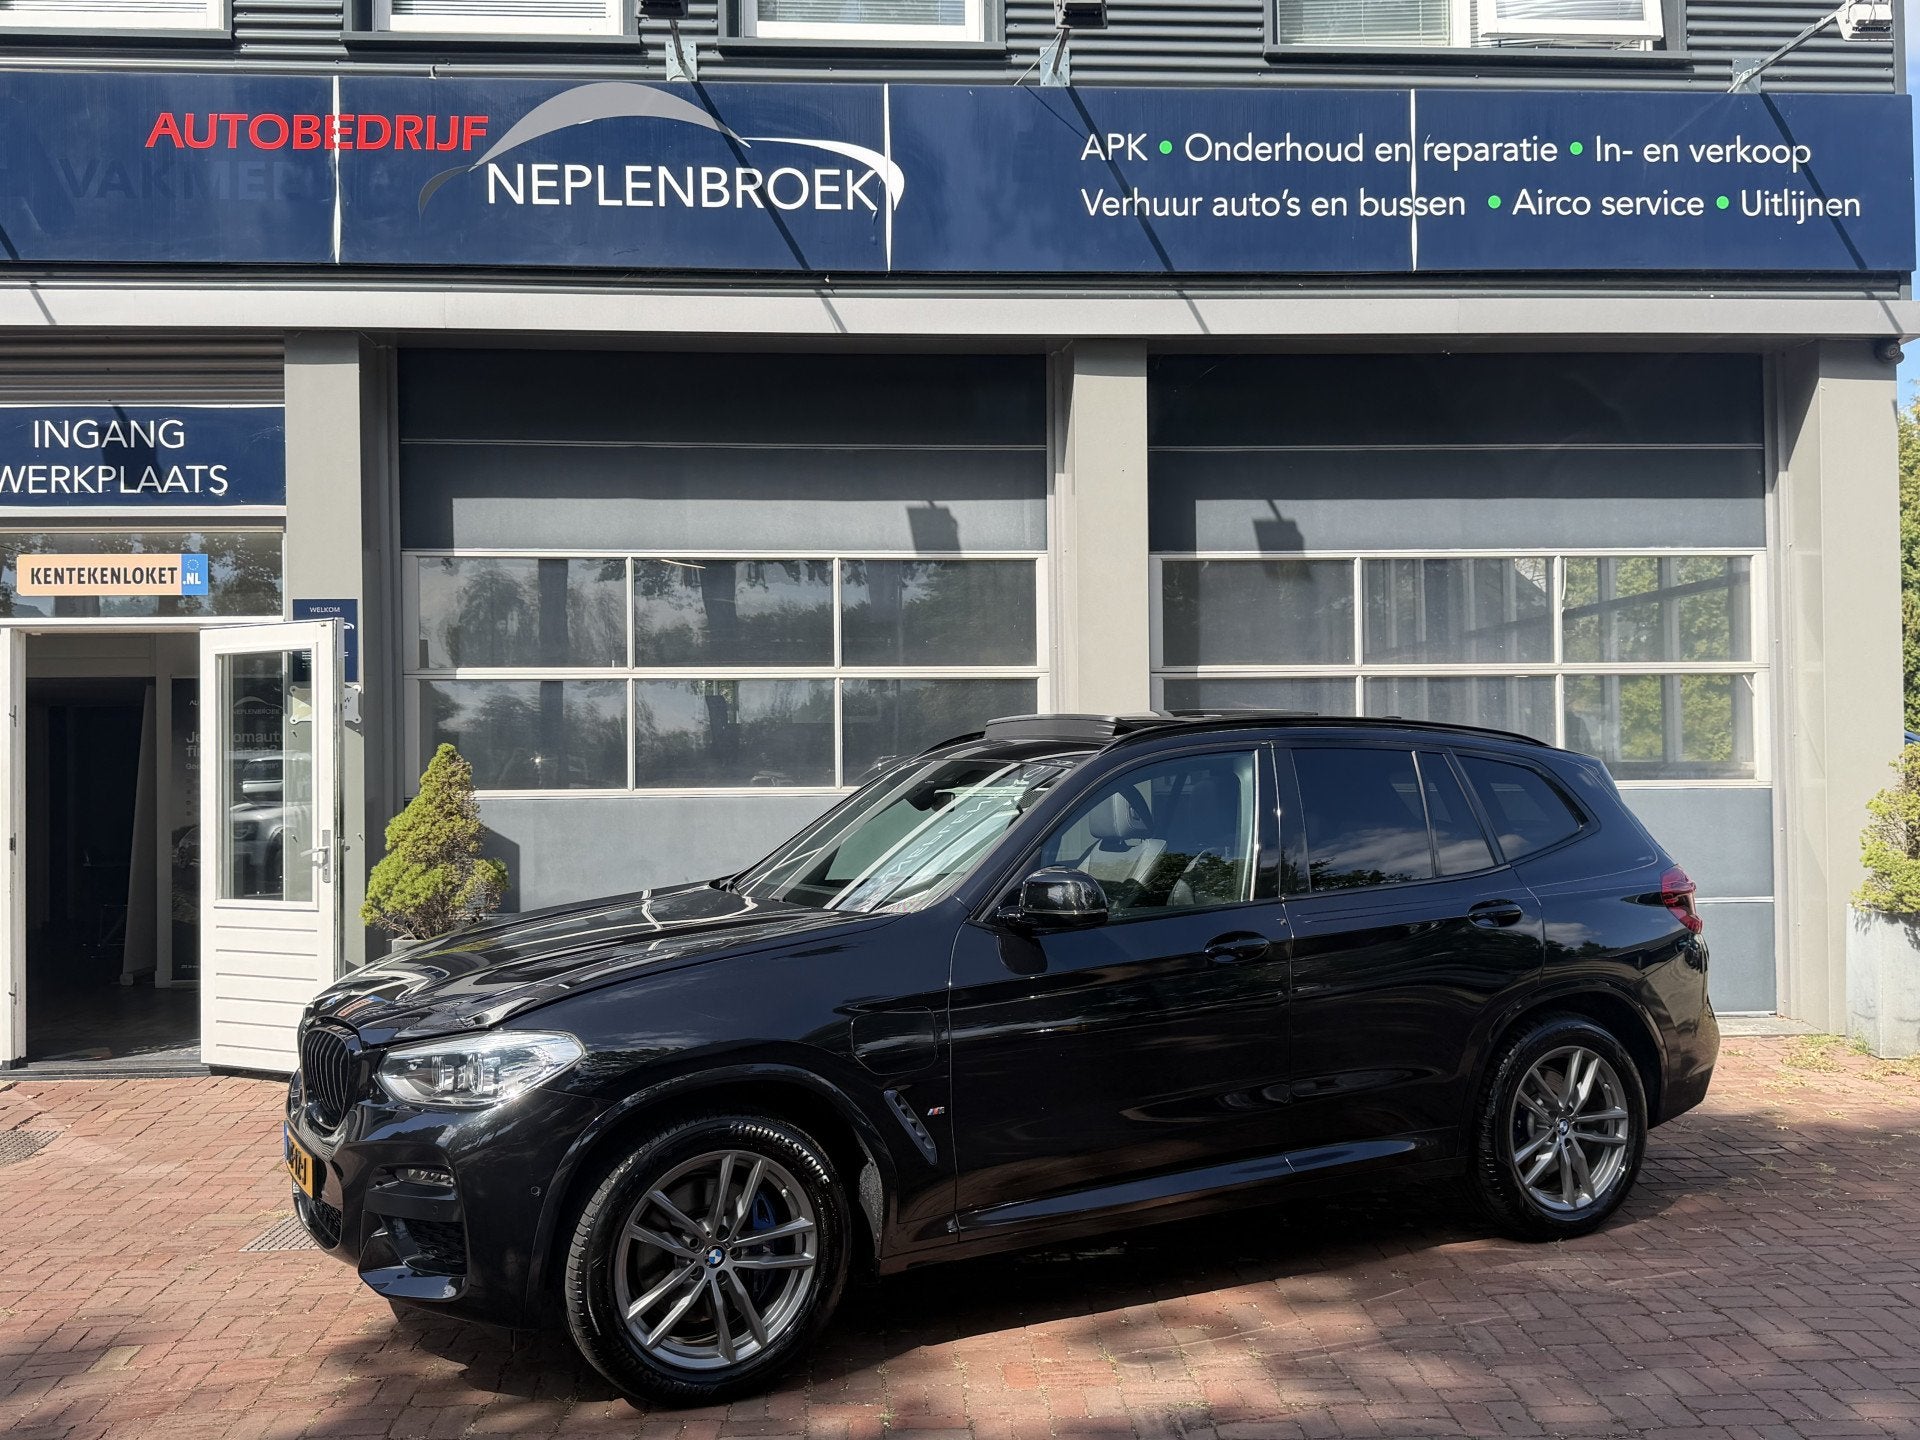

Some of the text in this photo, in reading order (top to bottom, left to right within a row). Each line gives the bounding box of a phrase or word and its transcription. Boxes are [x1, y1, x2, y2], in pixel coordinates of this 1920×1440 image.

[146, 112, 489, 151] AUTOBEDRIJF
[1081, 132, 1812, 172] APK Onderhoud en reparatie In- en verkoop
[487, 163, 878, 212] NEPLENBROEK
[1081, 187, 1203, 217] Verhuur
[1312, 197, 1348, 217] en
[1360, 188, 1467, 217] bussen
[1512, 189, 1591, 216] Airco
[1602, 190, 1705, 216] service
[1741, 189, 1861, 225] Uitlijnen
[33, 418, 186, 449] INGANG
[30, 567, 178, 586] KENTEKENLOKET
[309, 606, 341, 614] WELKOM
